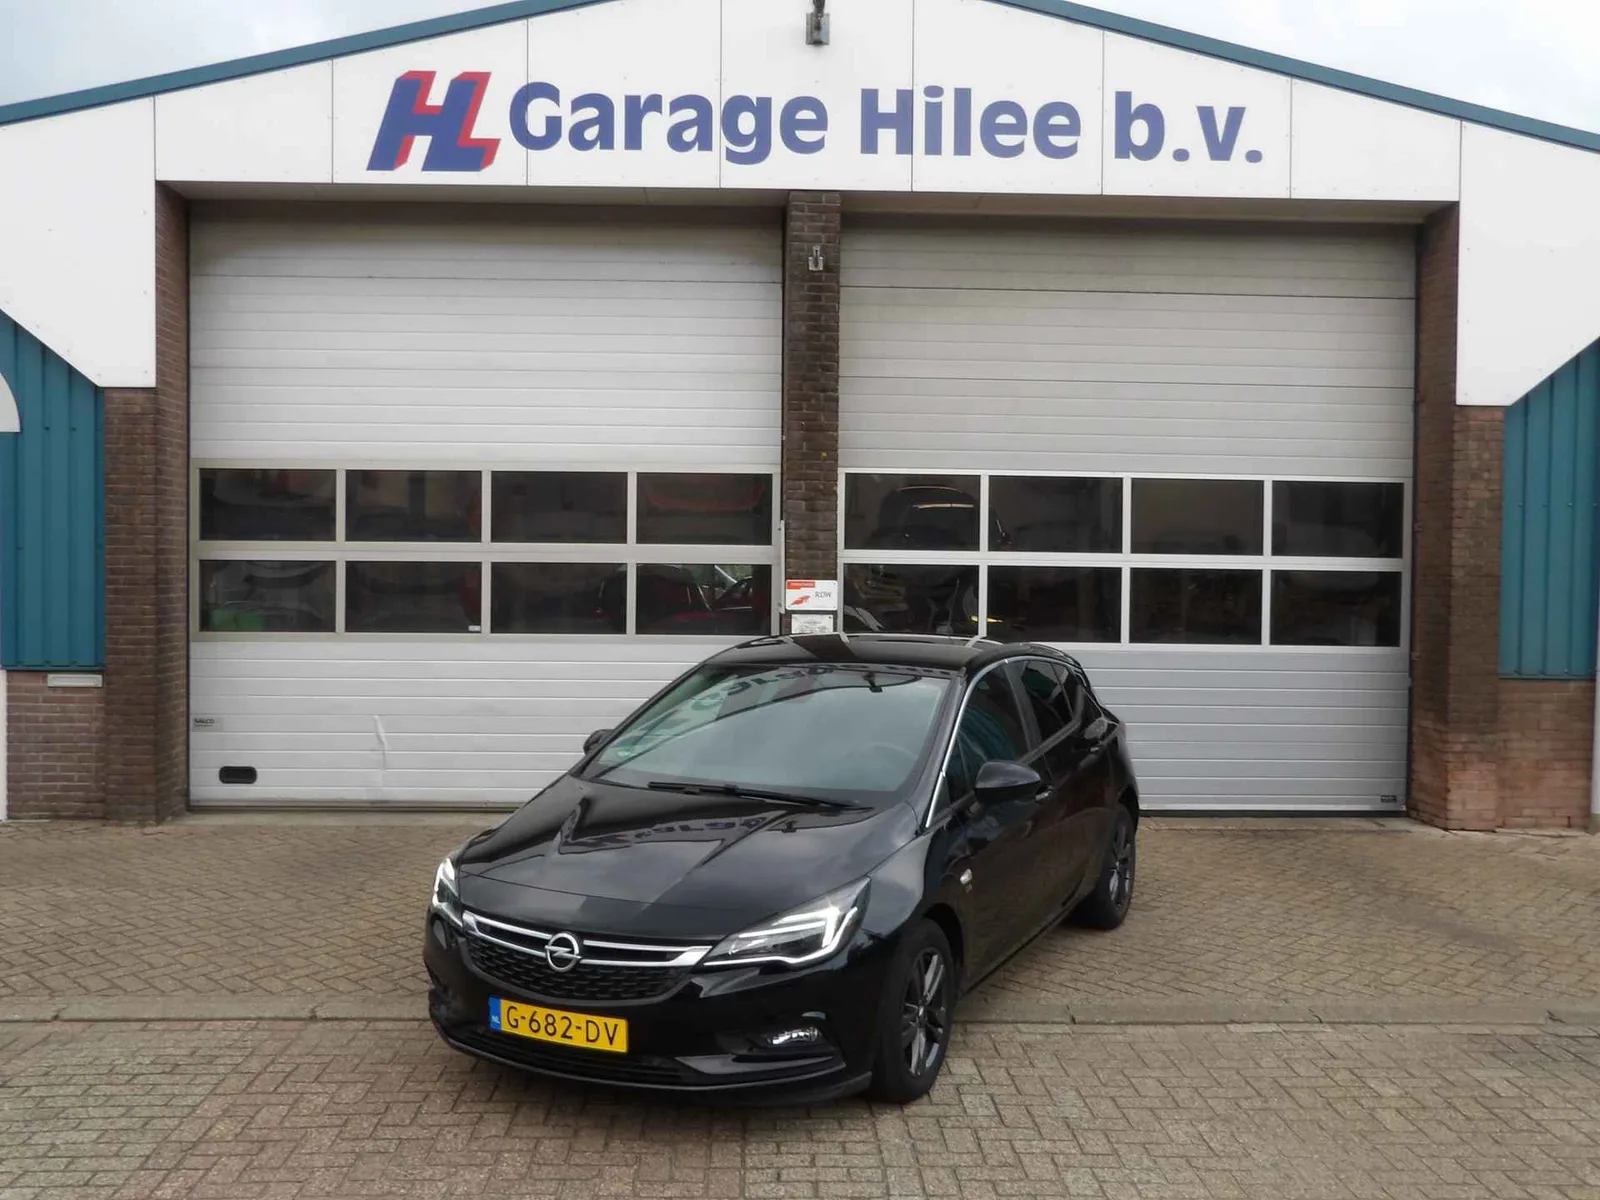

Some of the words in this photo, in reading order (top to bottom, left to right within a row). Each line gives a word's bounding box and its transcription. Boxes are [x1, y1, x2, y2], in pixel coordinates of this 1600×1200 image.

[510, 82, 828, 165] Garage
[860, 86, 1081, 159] Hilee
[1114, 91, 1263, 163] b.v.
[506, 1005, 619, 1046] G-682-DV
